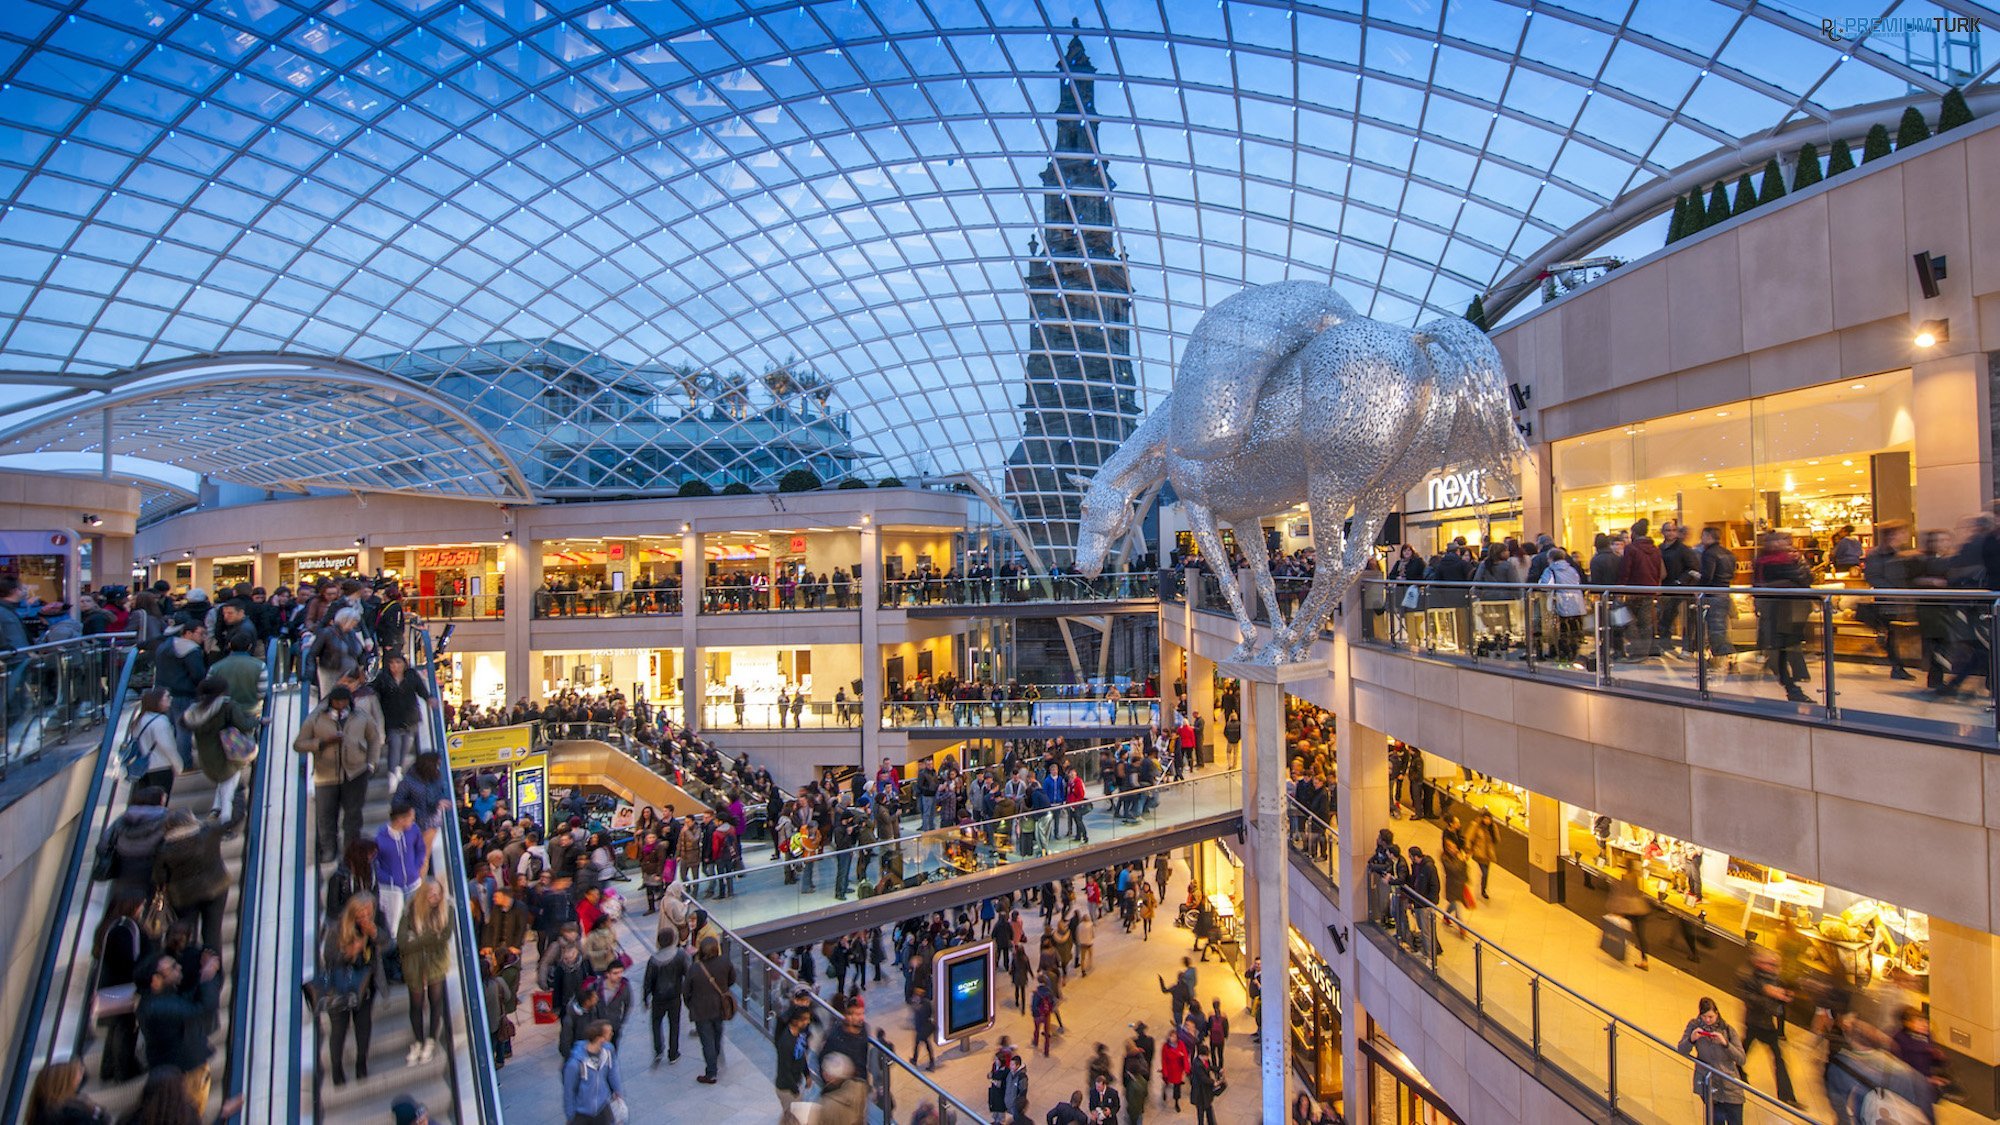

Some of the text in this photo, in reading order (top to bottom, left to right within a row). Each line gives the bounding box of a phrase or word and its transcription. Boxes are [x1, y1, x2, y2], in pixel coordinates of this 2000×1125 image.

[1428, 469, 1485, 510] next
[299, 558, 325, 569] handmade
[325, 557, 346, 570] burger
[958, 979, 979, 990] SONY
[1306, 954, 1342, 1014] FOSSIL
